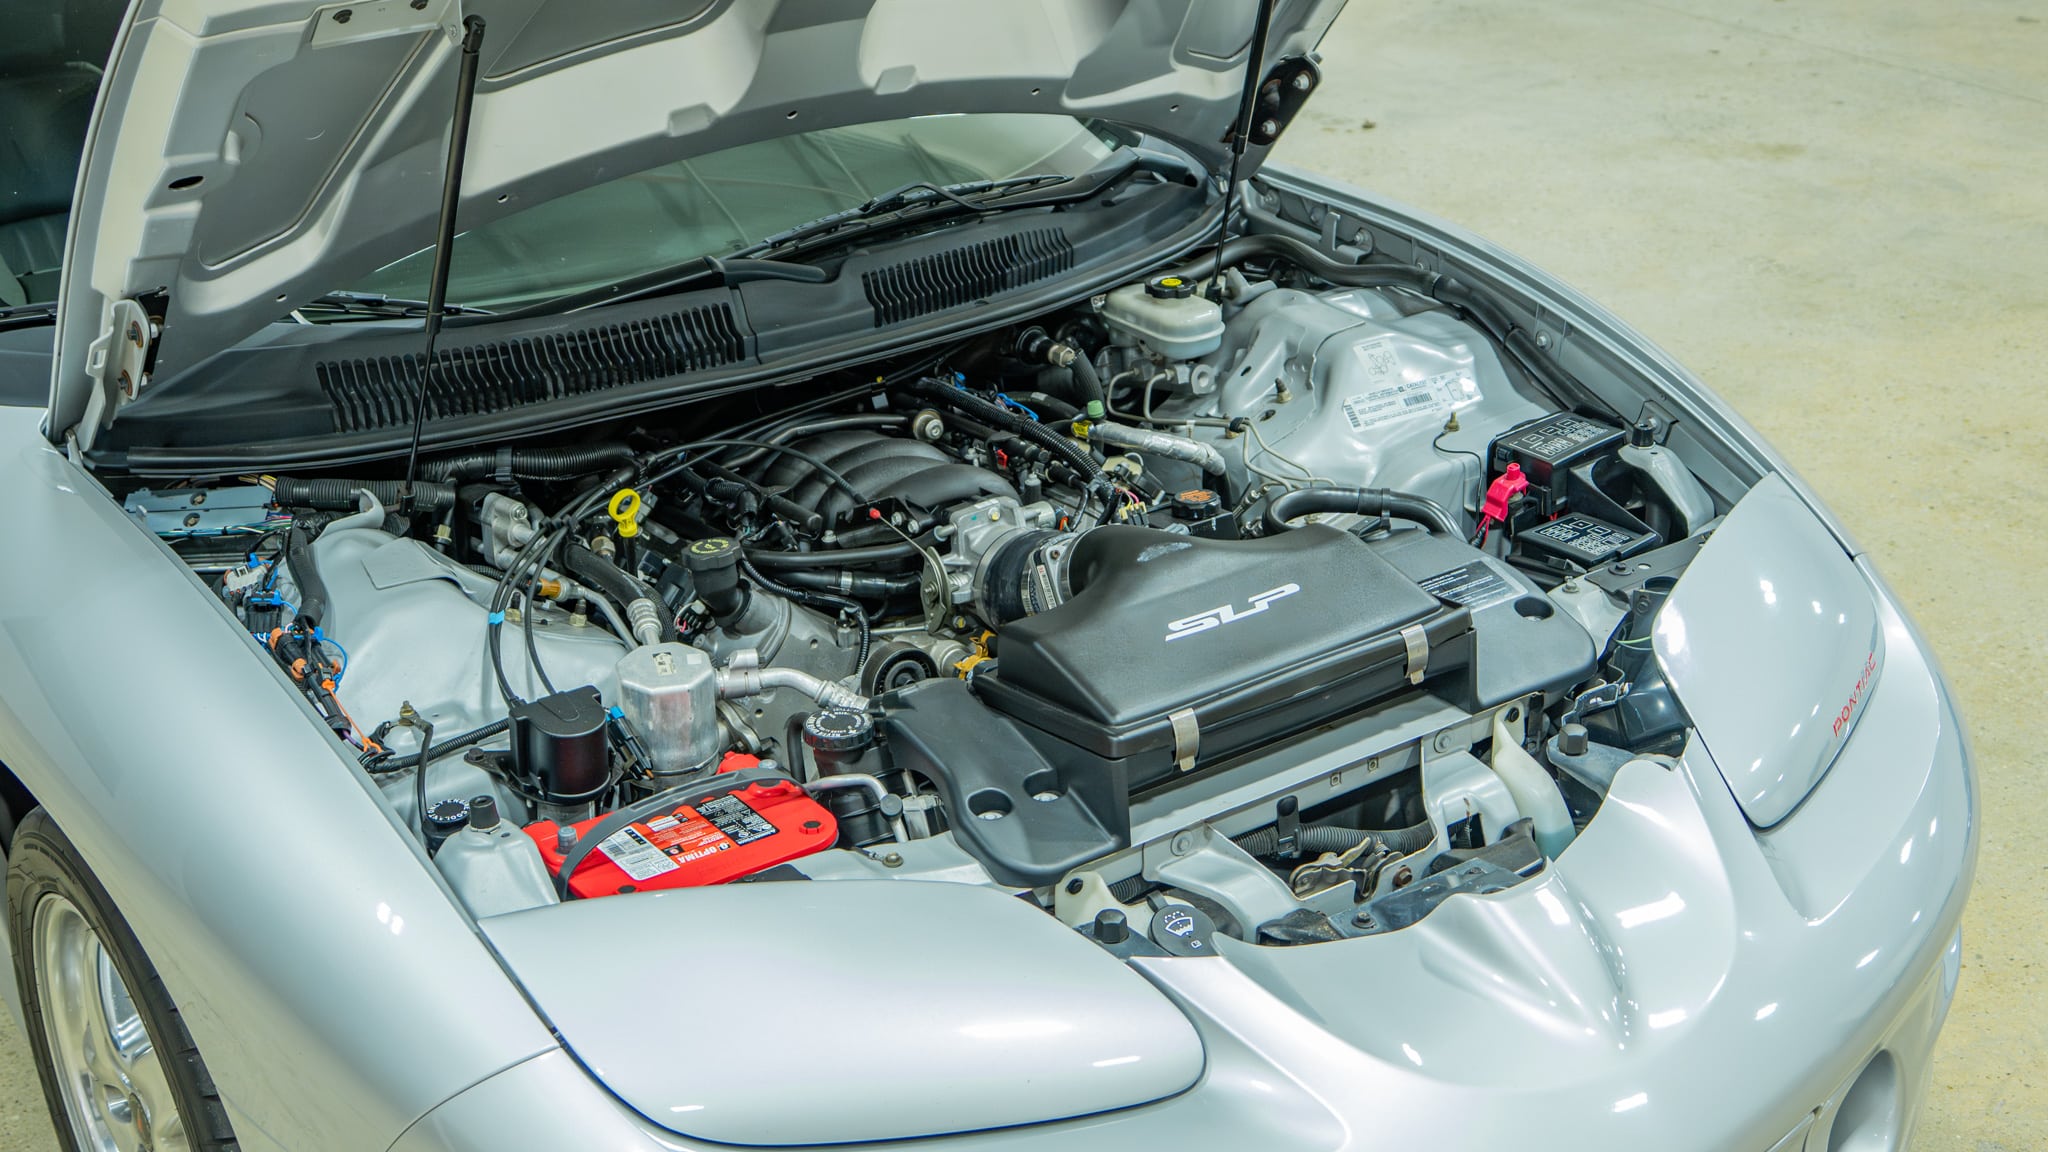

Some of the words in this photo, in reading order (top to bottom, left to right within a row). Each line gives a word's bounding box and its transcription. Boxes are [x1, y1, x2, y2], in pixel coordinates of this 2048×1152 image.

[1165, 582, 1301, 642] SLP
[1832, 651, 1877, 737] PONTIAC
[677, 846, 718, 864] OPTIMA
